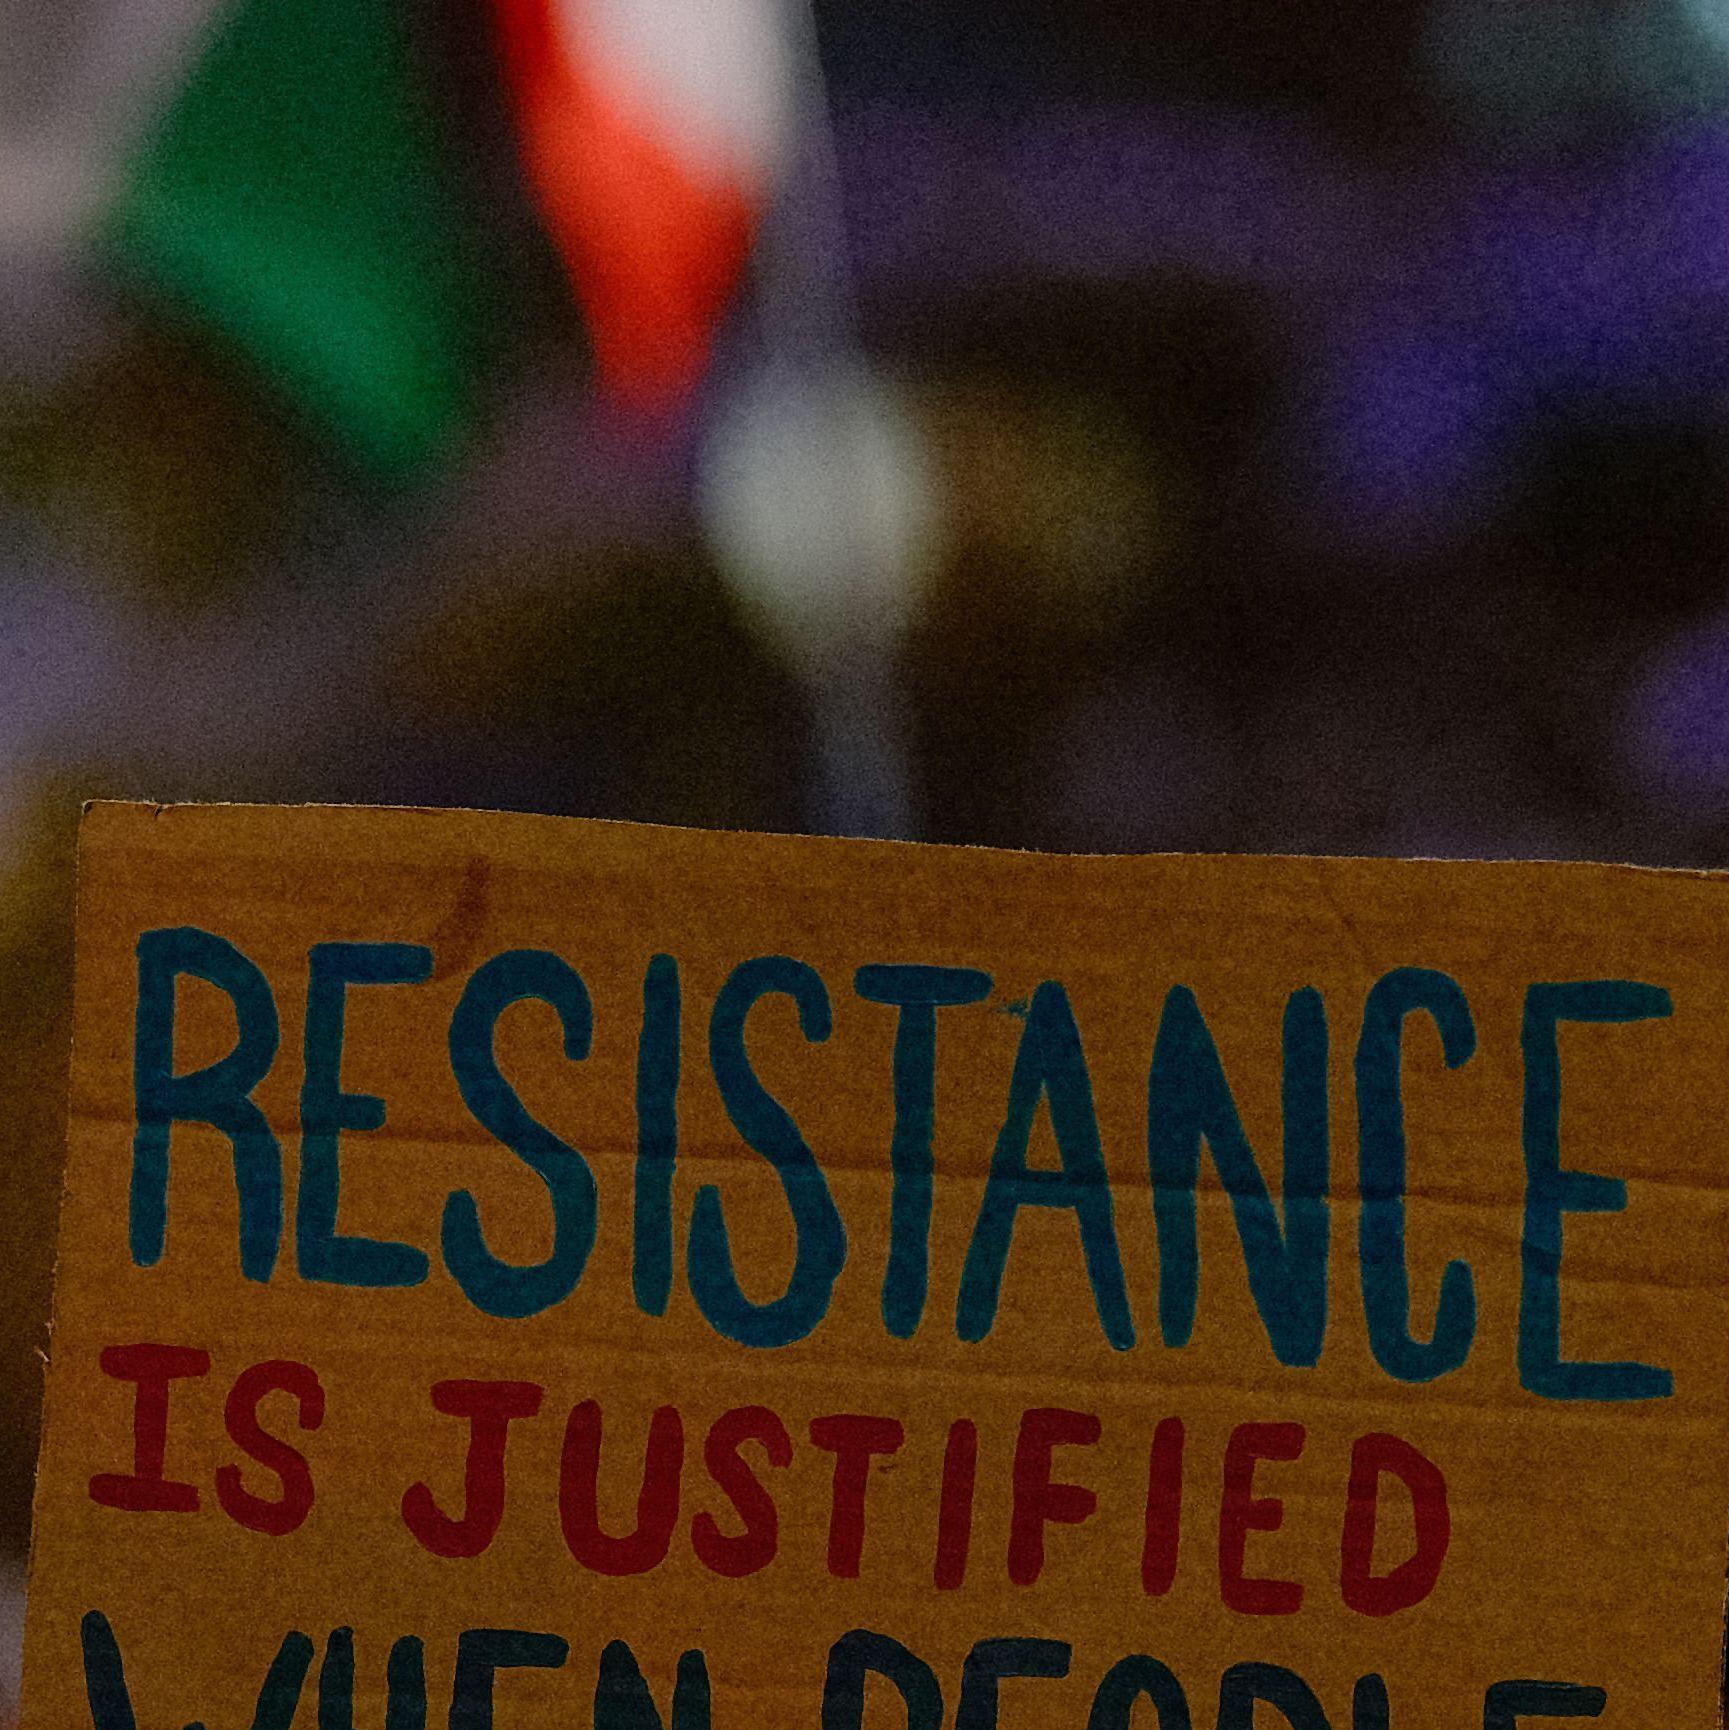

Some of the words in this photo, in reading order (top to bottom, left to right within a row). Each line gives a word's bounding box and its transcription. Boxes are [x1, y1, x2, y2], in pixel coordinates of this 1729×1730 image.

[128, 925, 1674, 1400] RESISTANCE
[88, 1342, 326, 1536] IS
[402, 1378, 1451, 1617] JUSTIFIED
